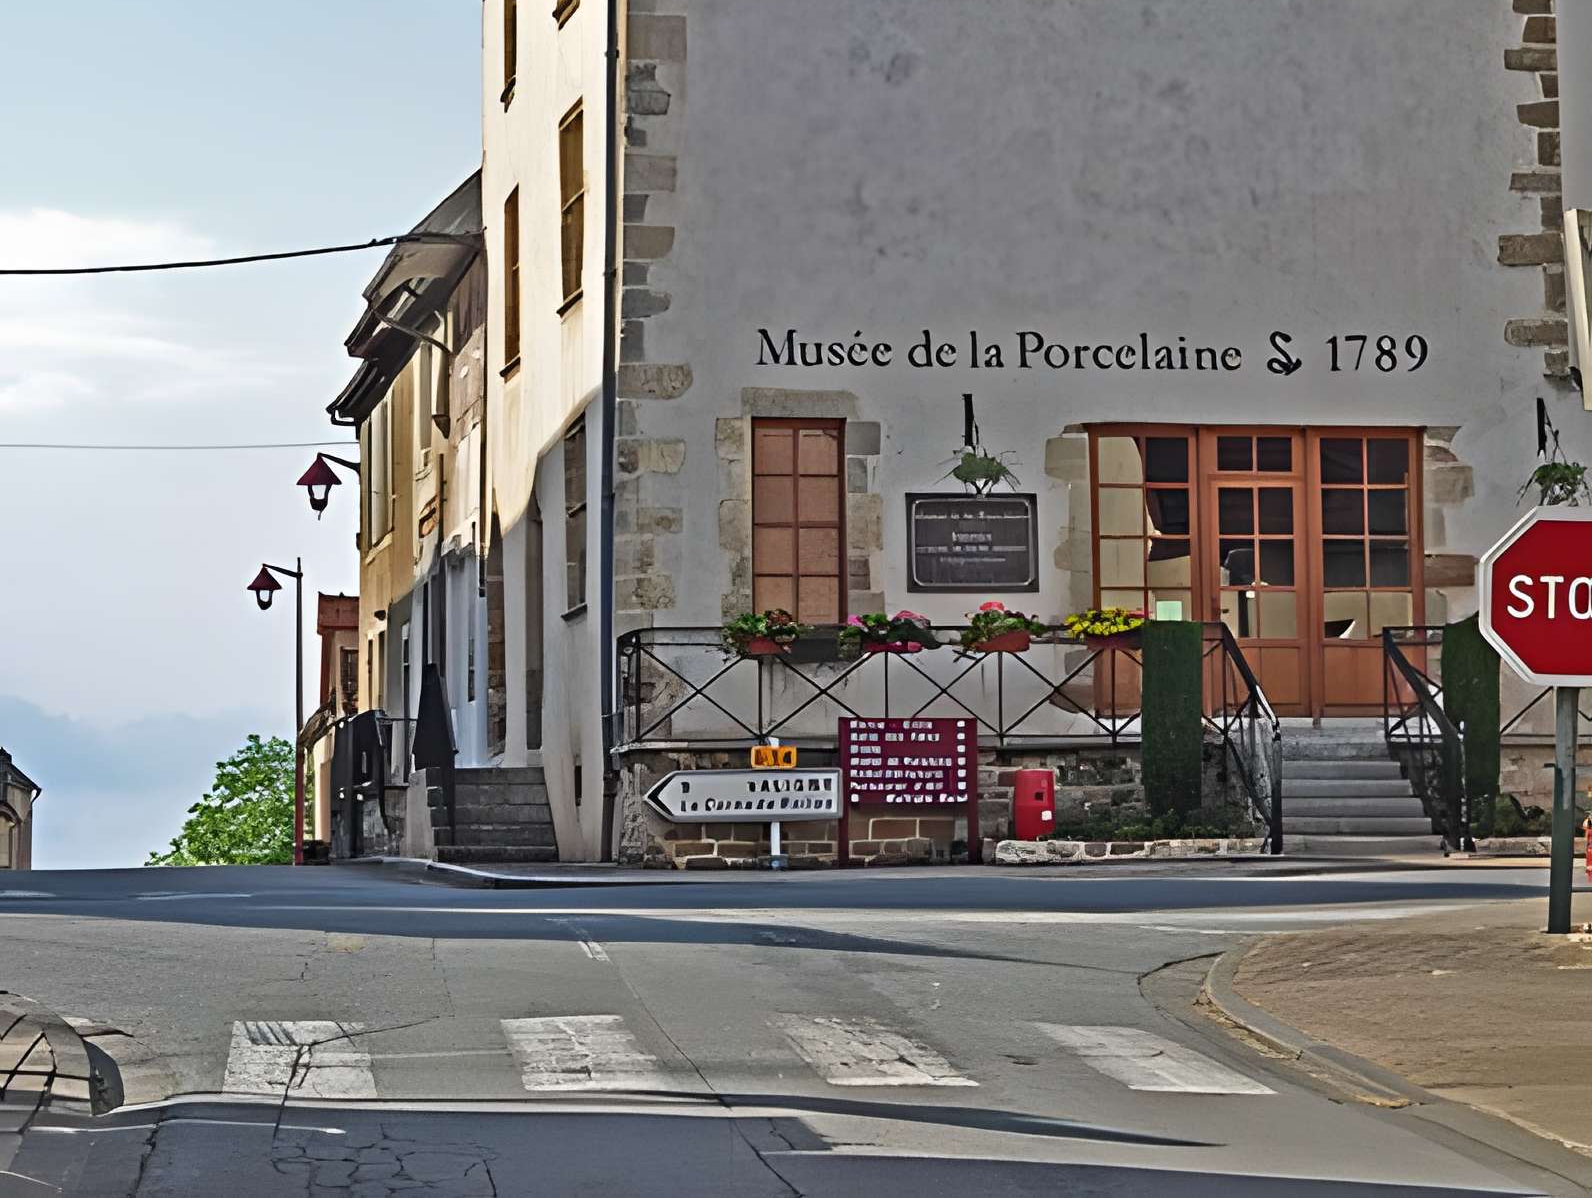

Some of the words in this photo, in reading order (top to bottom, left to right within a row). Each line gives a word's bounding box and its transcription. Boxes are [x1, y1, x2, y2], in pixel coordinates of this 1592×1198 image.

[755, 328, 893, 367] Musée
[907, 329, 957, 368] de
[969, 330, 1005, 369] la
[1015, 331, 1242, 371] Porcelaine
[1325, 334, 1428, 373] 1789
